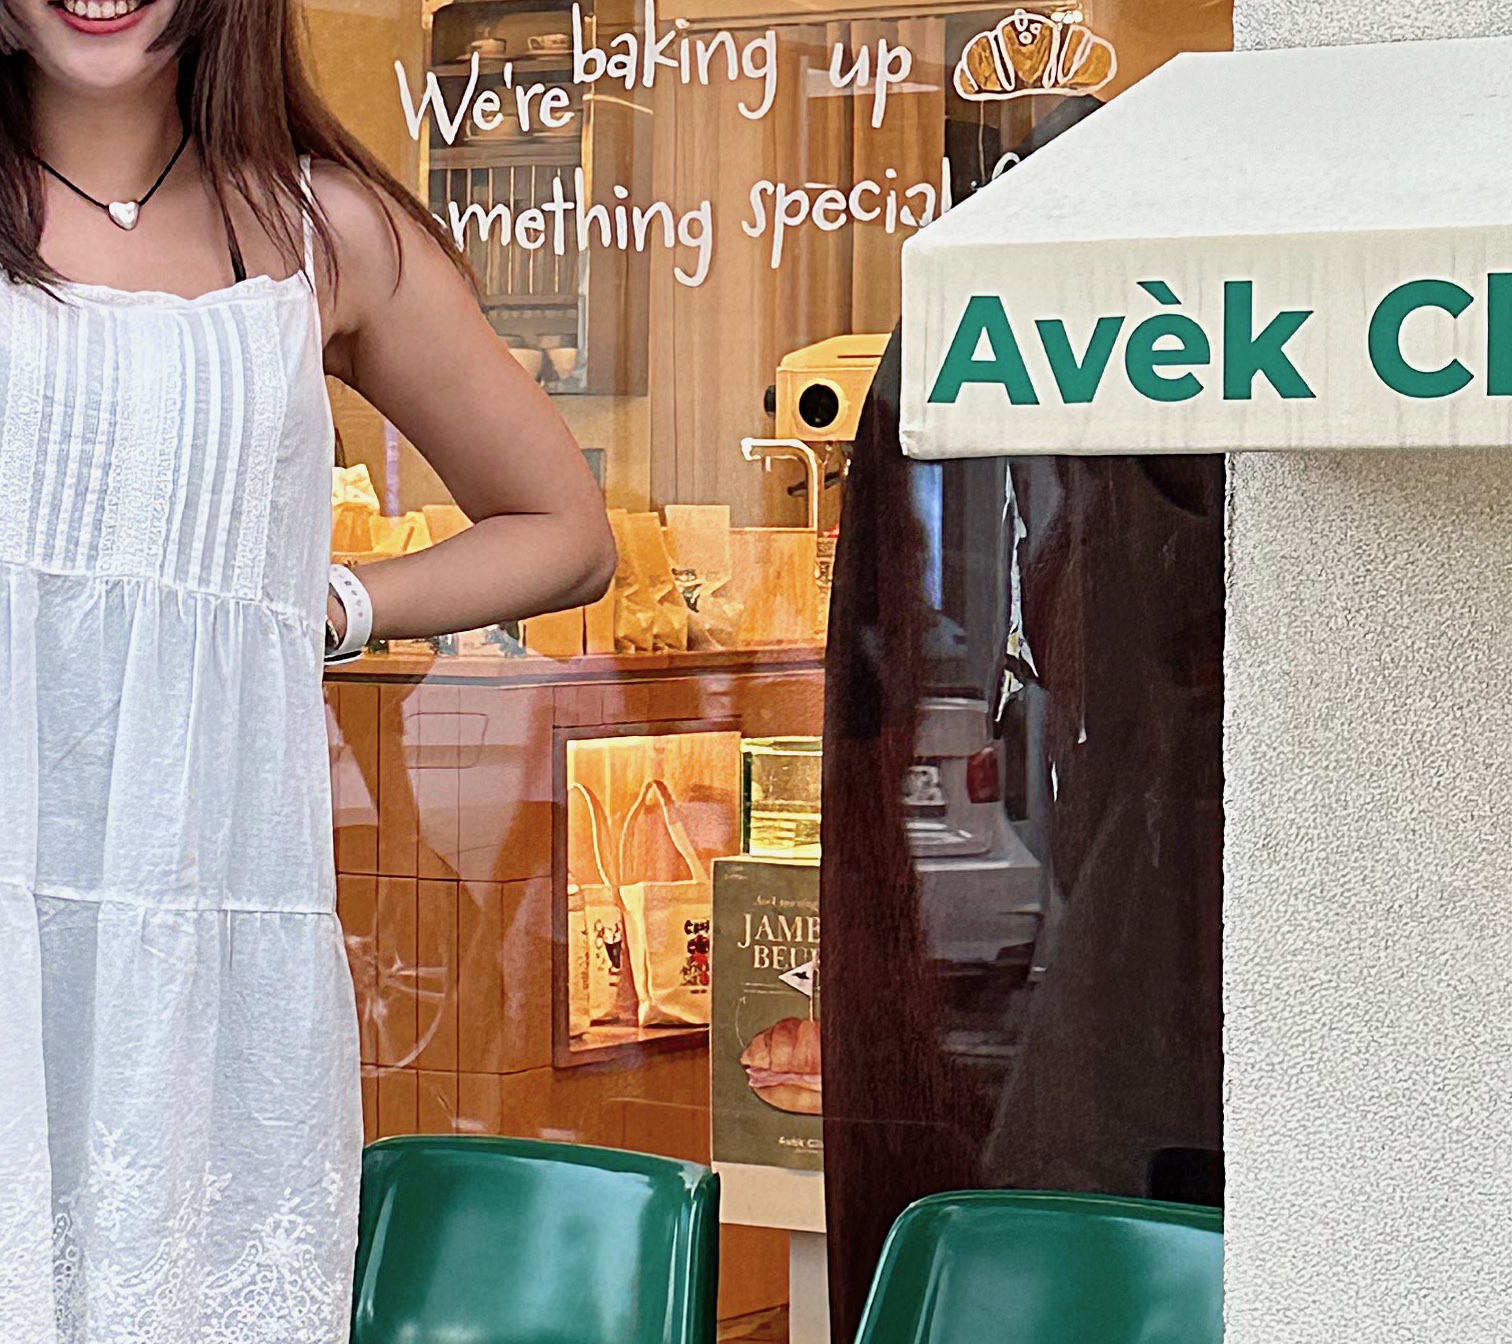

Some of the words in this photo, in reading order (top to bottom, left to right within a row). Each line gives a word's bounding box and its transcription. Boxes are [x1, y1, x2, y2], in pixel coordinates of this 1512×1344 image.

[393, 51, 576, 146] We're
[828, 37, 913, 129] up
[432, 167, 714, 288] mething
[740, 156, 952, 269] special
[926, 280, 1318, 406] Avèk
